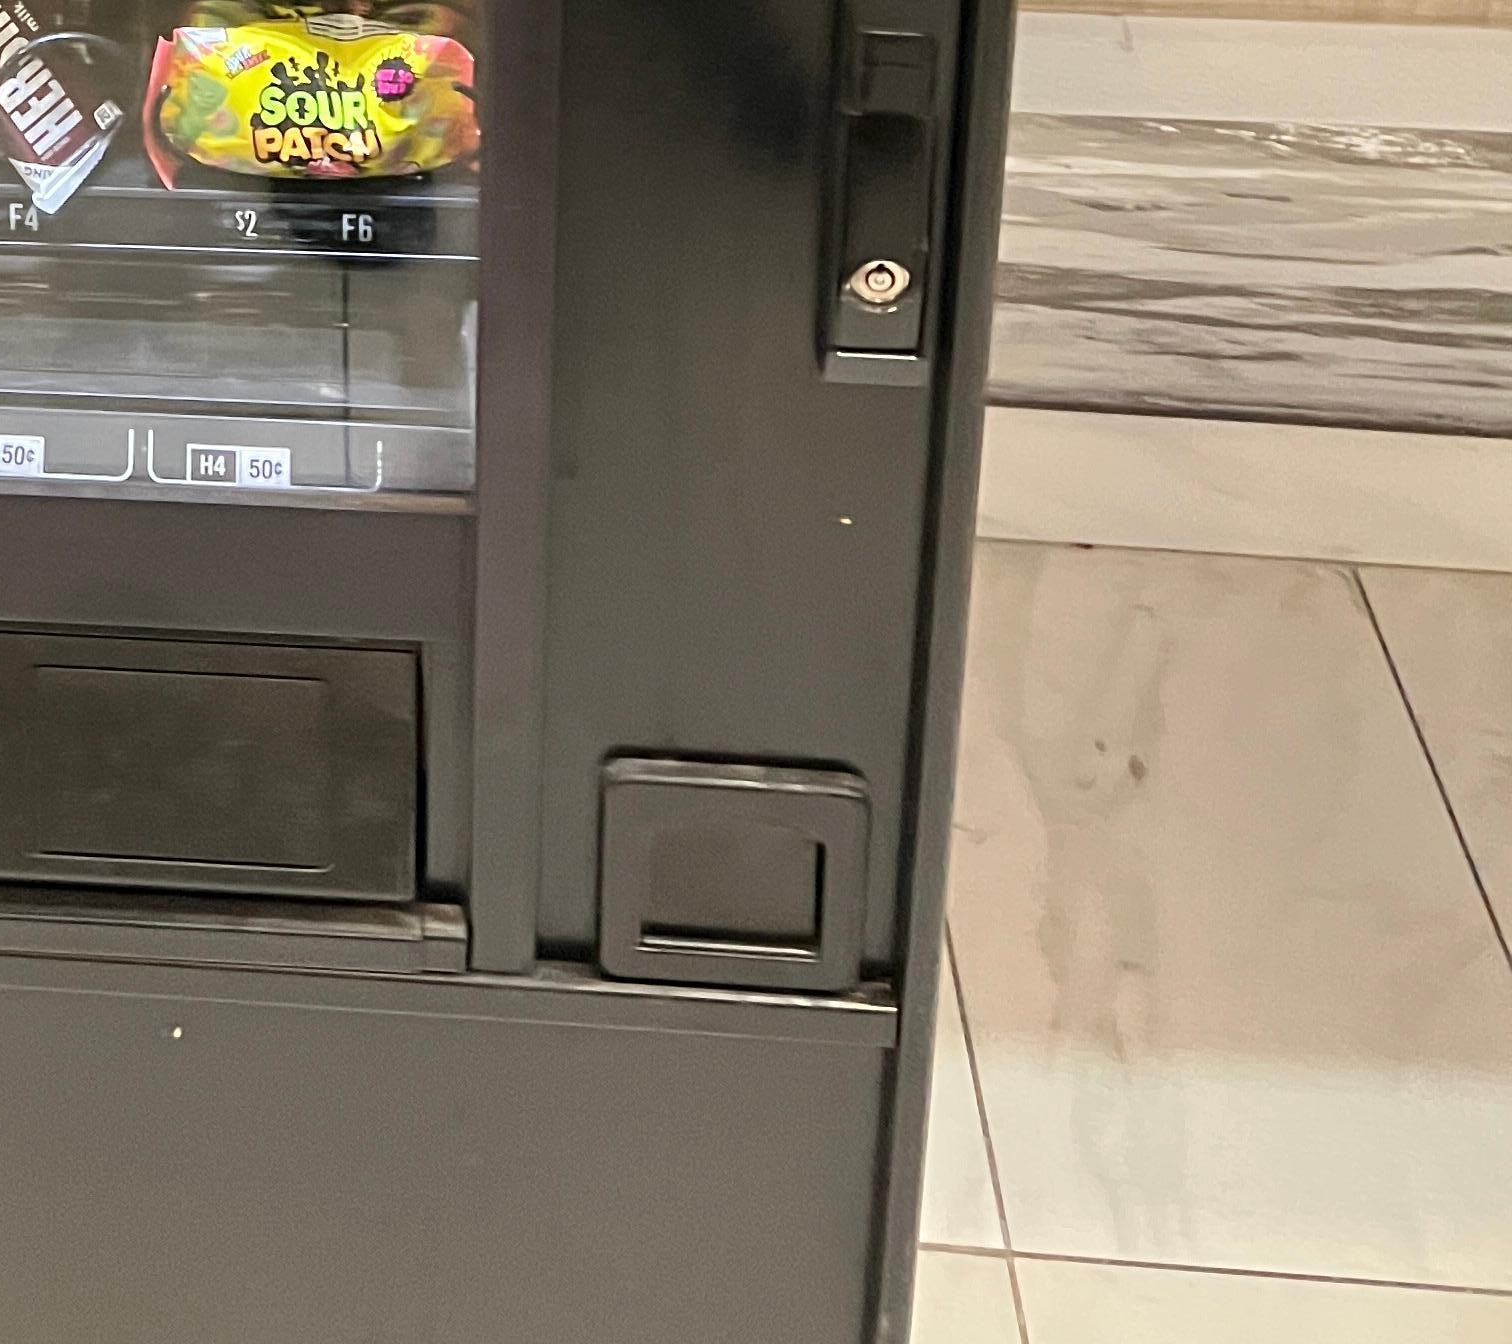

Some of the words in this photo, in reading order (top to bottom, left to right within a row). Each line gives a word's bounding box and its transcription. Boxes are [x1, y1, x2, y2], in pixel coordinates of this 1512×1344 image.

[259, 85, 369, 131] SOUR
[9, 202, 40, 231] F4
[342, 213, 373, 242] F6
[198, 454, 227, 477] H4
